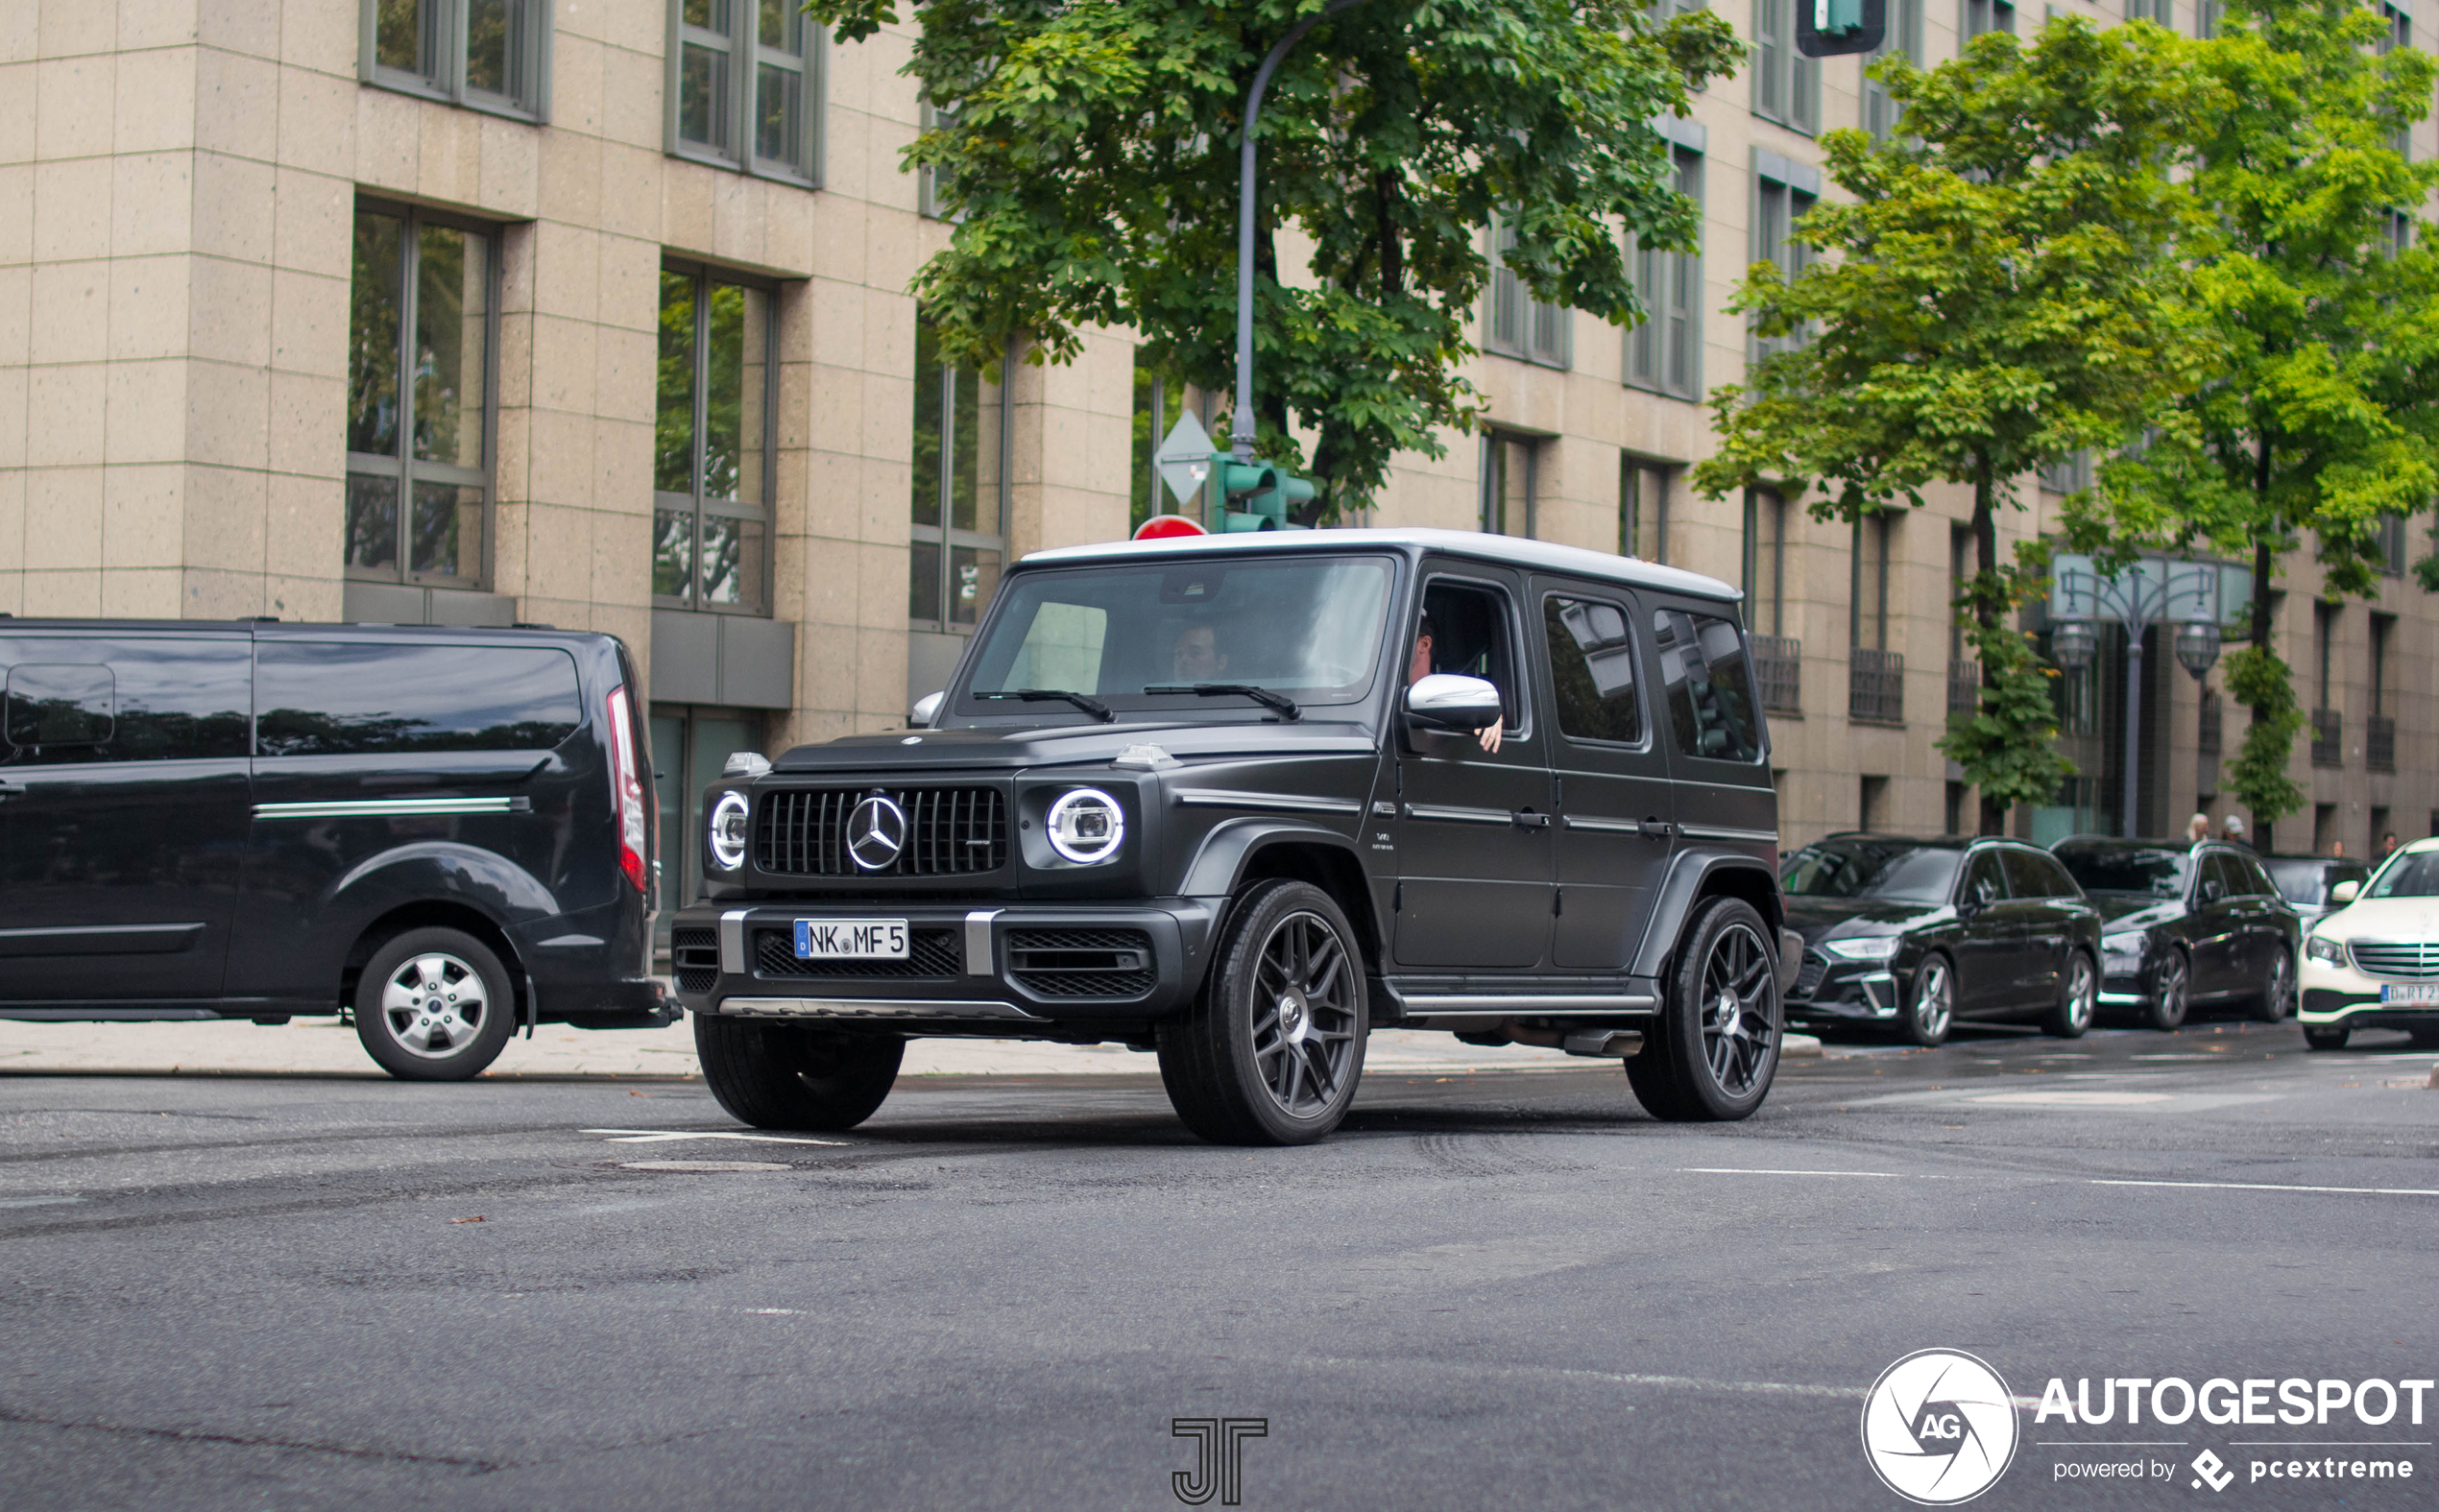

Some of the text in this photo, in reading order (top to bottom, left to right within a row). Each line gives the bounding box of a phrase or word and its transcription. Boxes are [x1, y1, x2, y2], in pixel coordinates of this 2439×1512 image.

[809, 925, 904, 952] NK MF 5
[800, 942, 806, 951] D
[2391, 985, 2399, 999] D
[2408, 985, 2424, 999] RT
